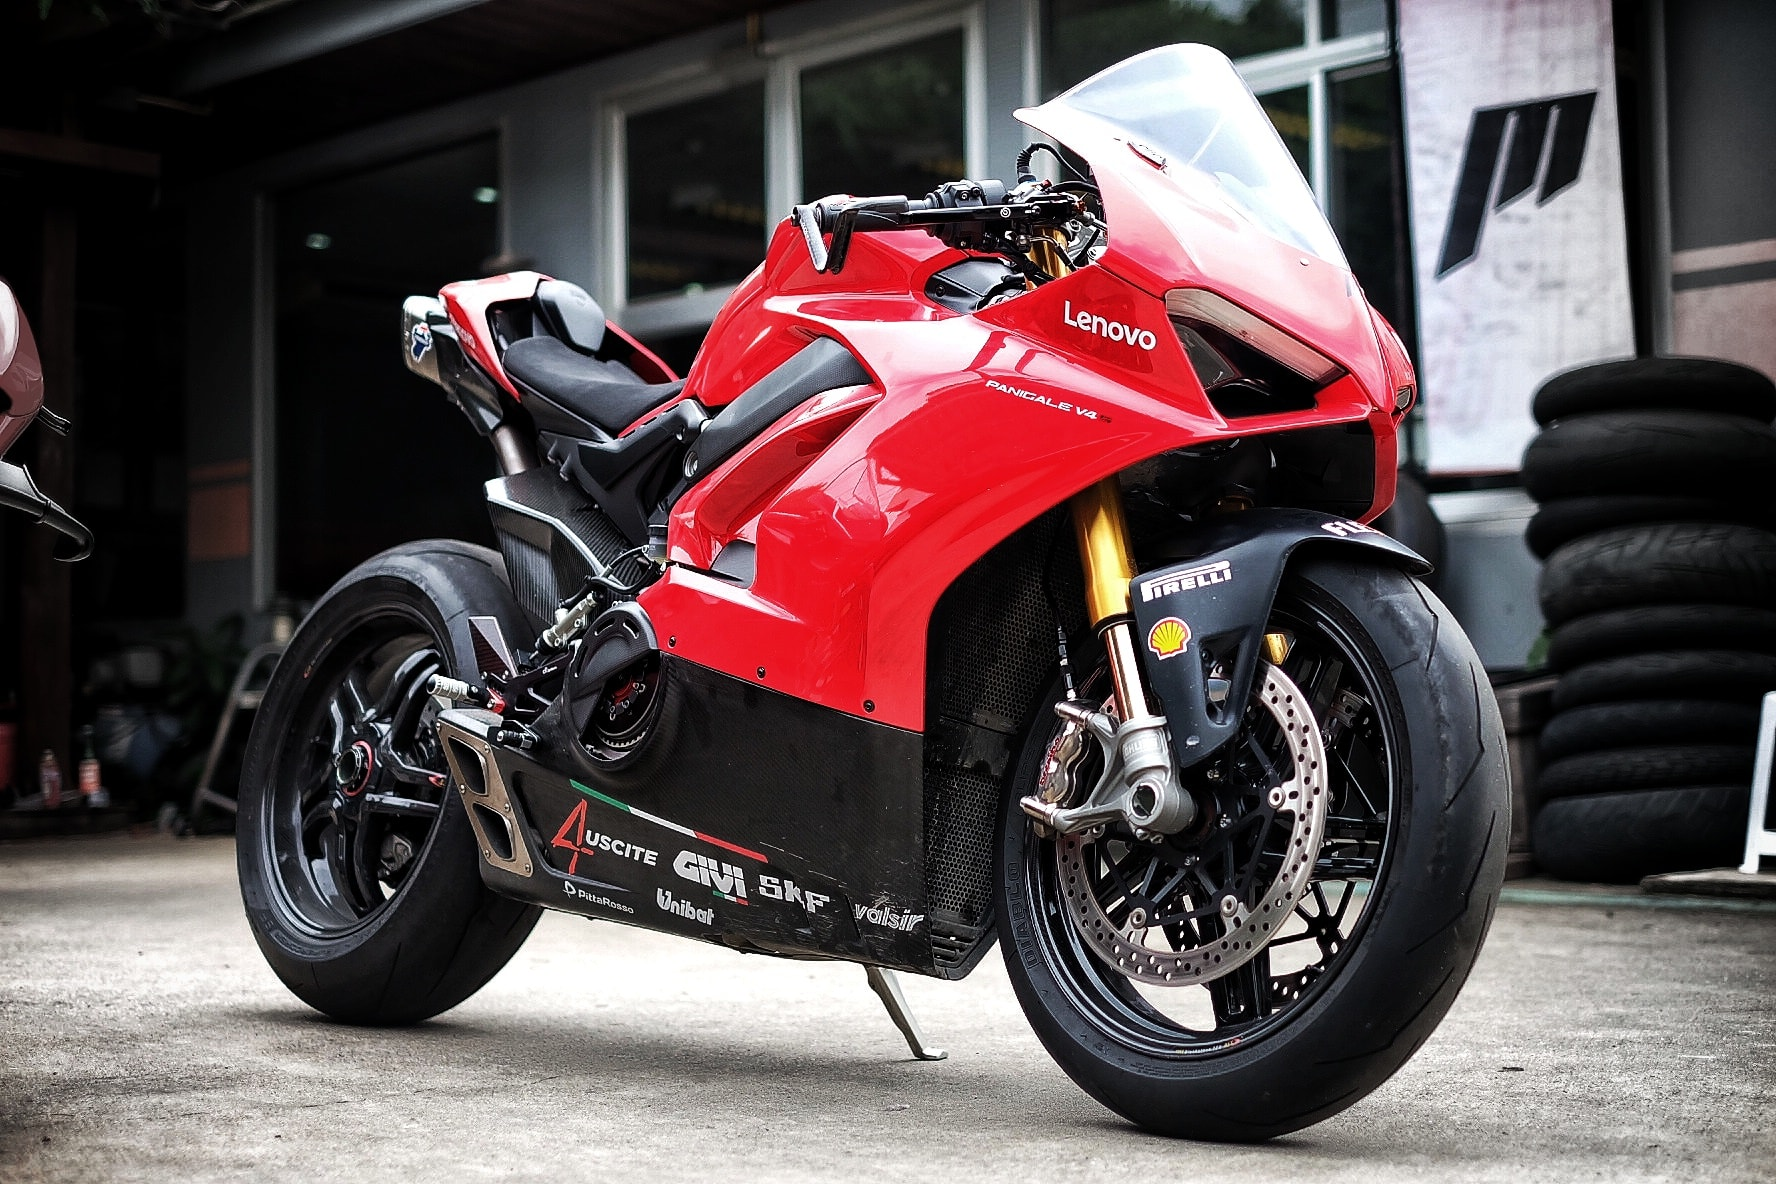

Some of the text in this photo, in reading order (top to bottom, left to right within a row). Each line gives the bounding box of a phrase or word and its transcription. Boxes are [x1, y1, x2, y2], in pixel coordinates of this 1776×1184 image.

[1064, 300, 1157, 351] Lenovo
[985, 379, 1074, 412] PANIGALE
[1075, 406, 1098, 420] V4
[1140, 560, 1232, 603] PIRELLI
[673, 850, 748, 899] GIVI
[758, 874, 830, 914] SKF
[578, 889, 635, 914] PittaRosso
[656, 887, 715, 926] Unibat
[854, 903, 925, 932] valsir
[1007, 862, 1041, 969] DIABLO
